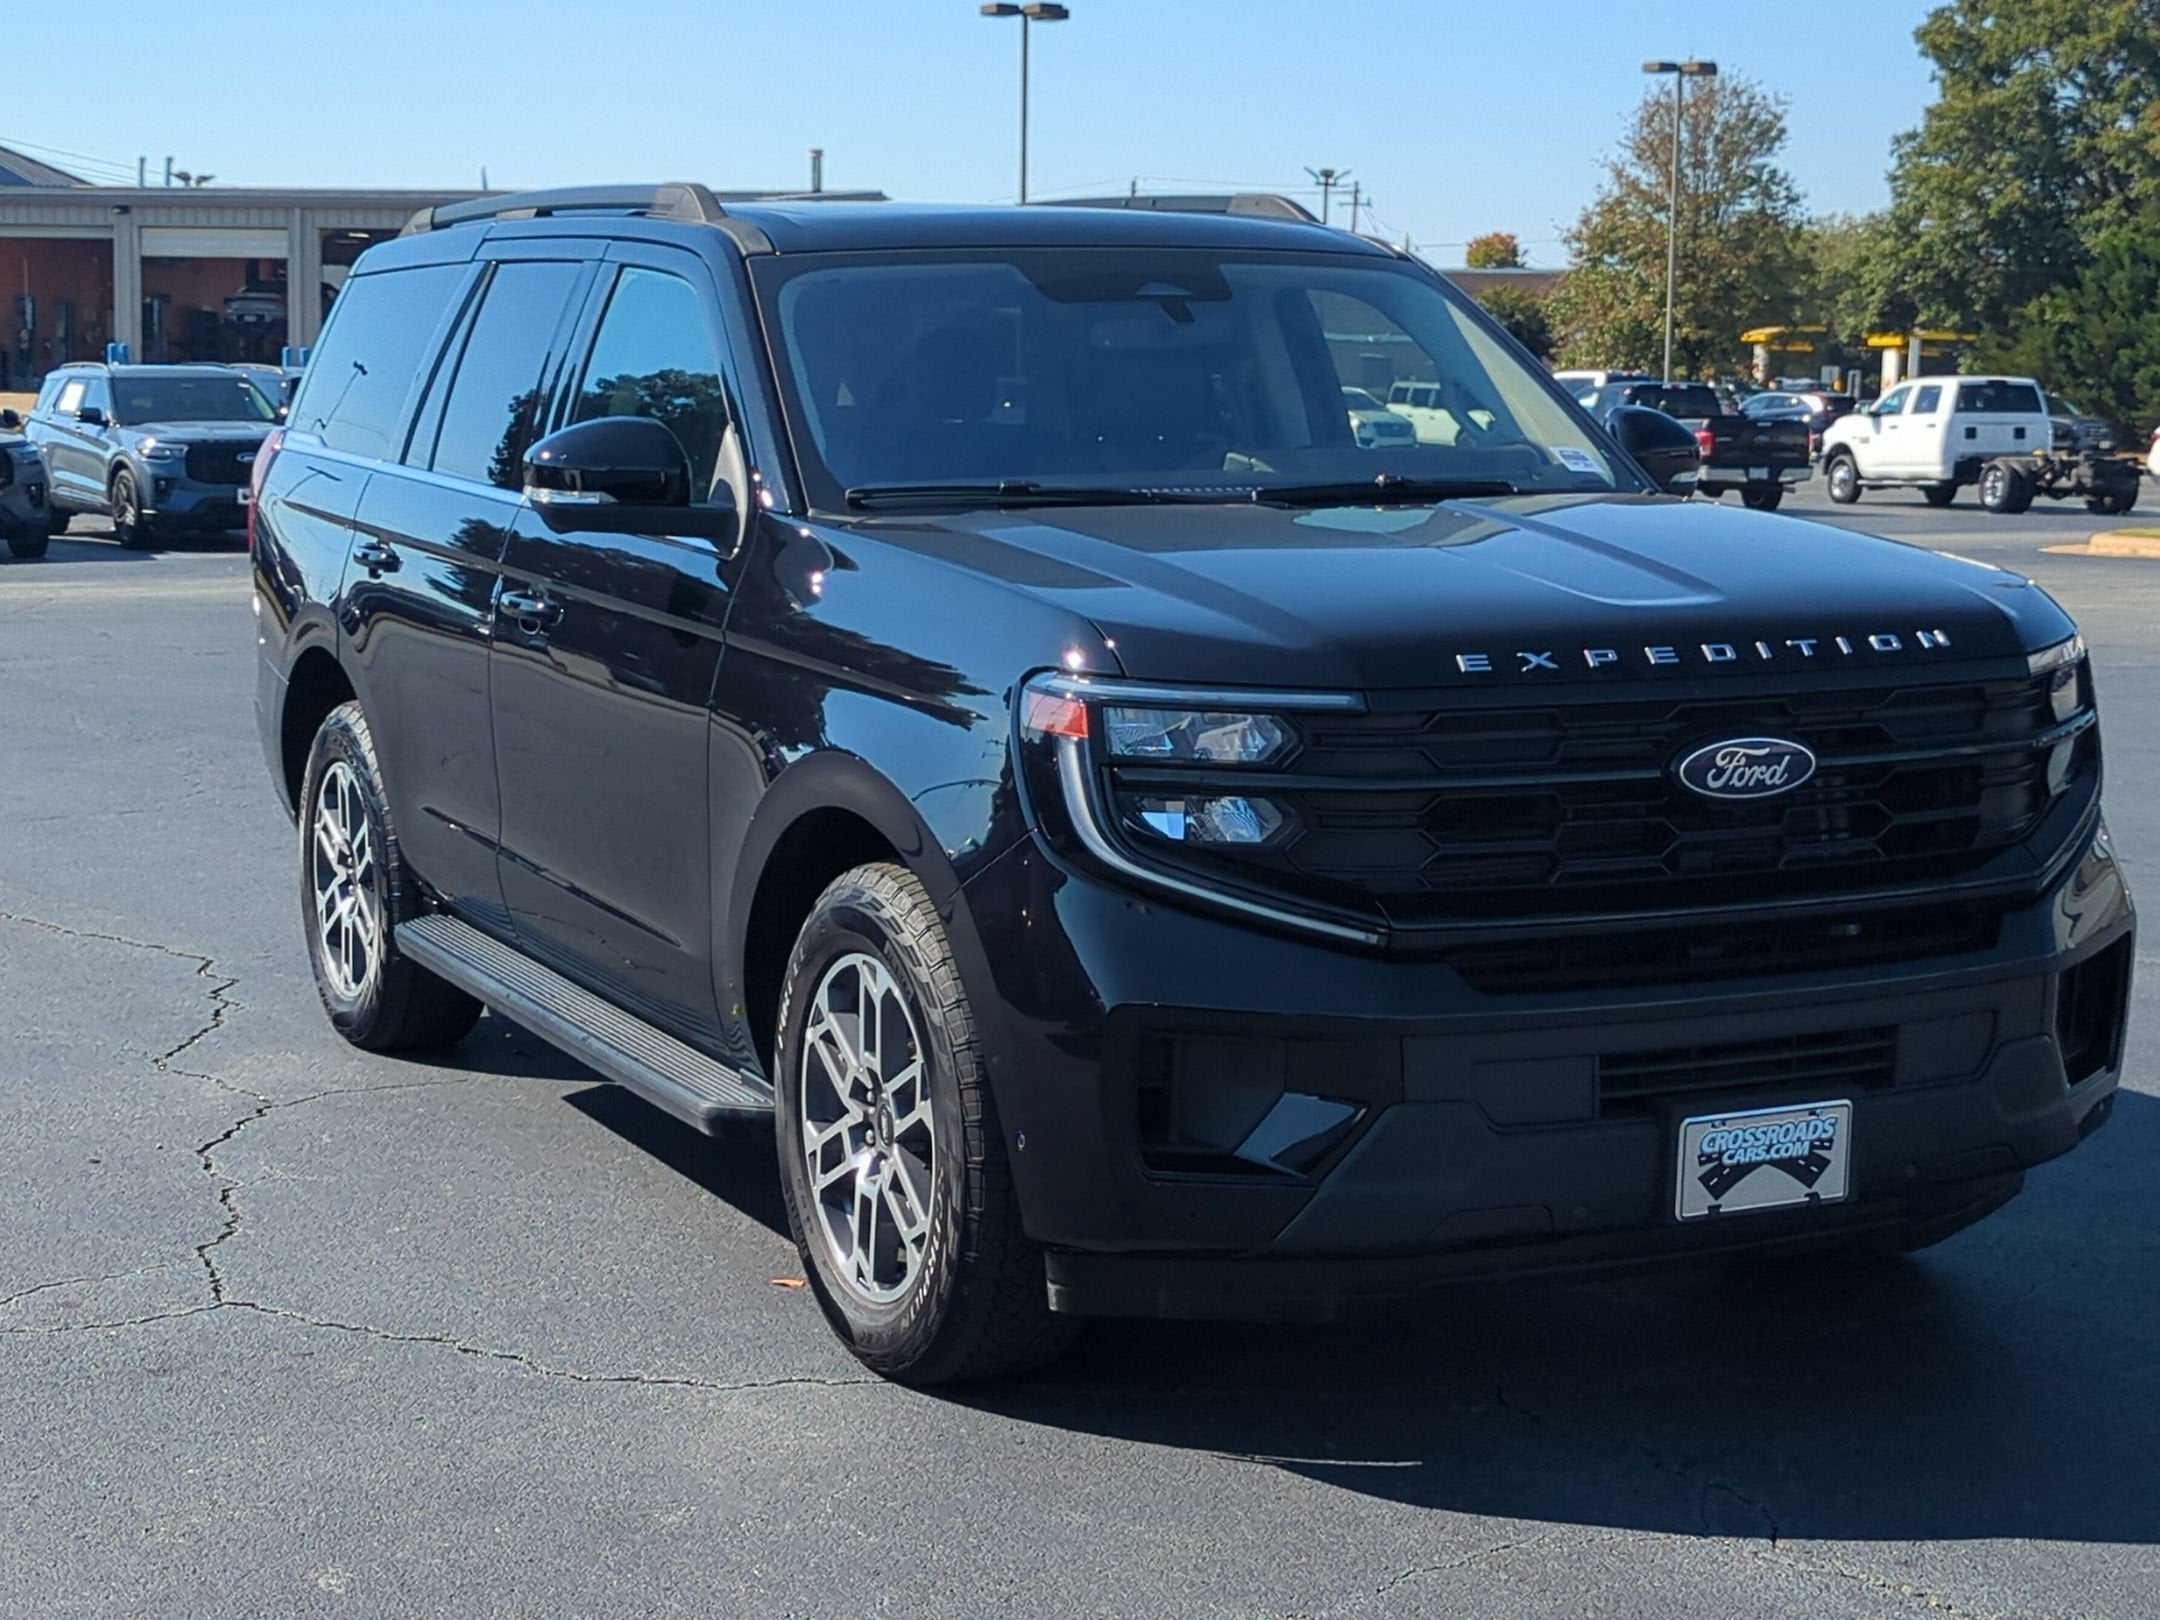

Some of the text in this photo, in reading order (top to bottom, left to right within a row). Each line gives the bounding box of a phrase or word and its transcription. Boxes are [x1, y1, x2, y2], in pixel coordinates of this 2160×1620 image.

[1455, 628, 1951, 673] EXPEDITION
[1706, 746, 1791, 789] Ford
[1701, 1116, 1837, 1153] CROSSROADS
[1721, 1140, 1811, 1166] CARS.COM
